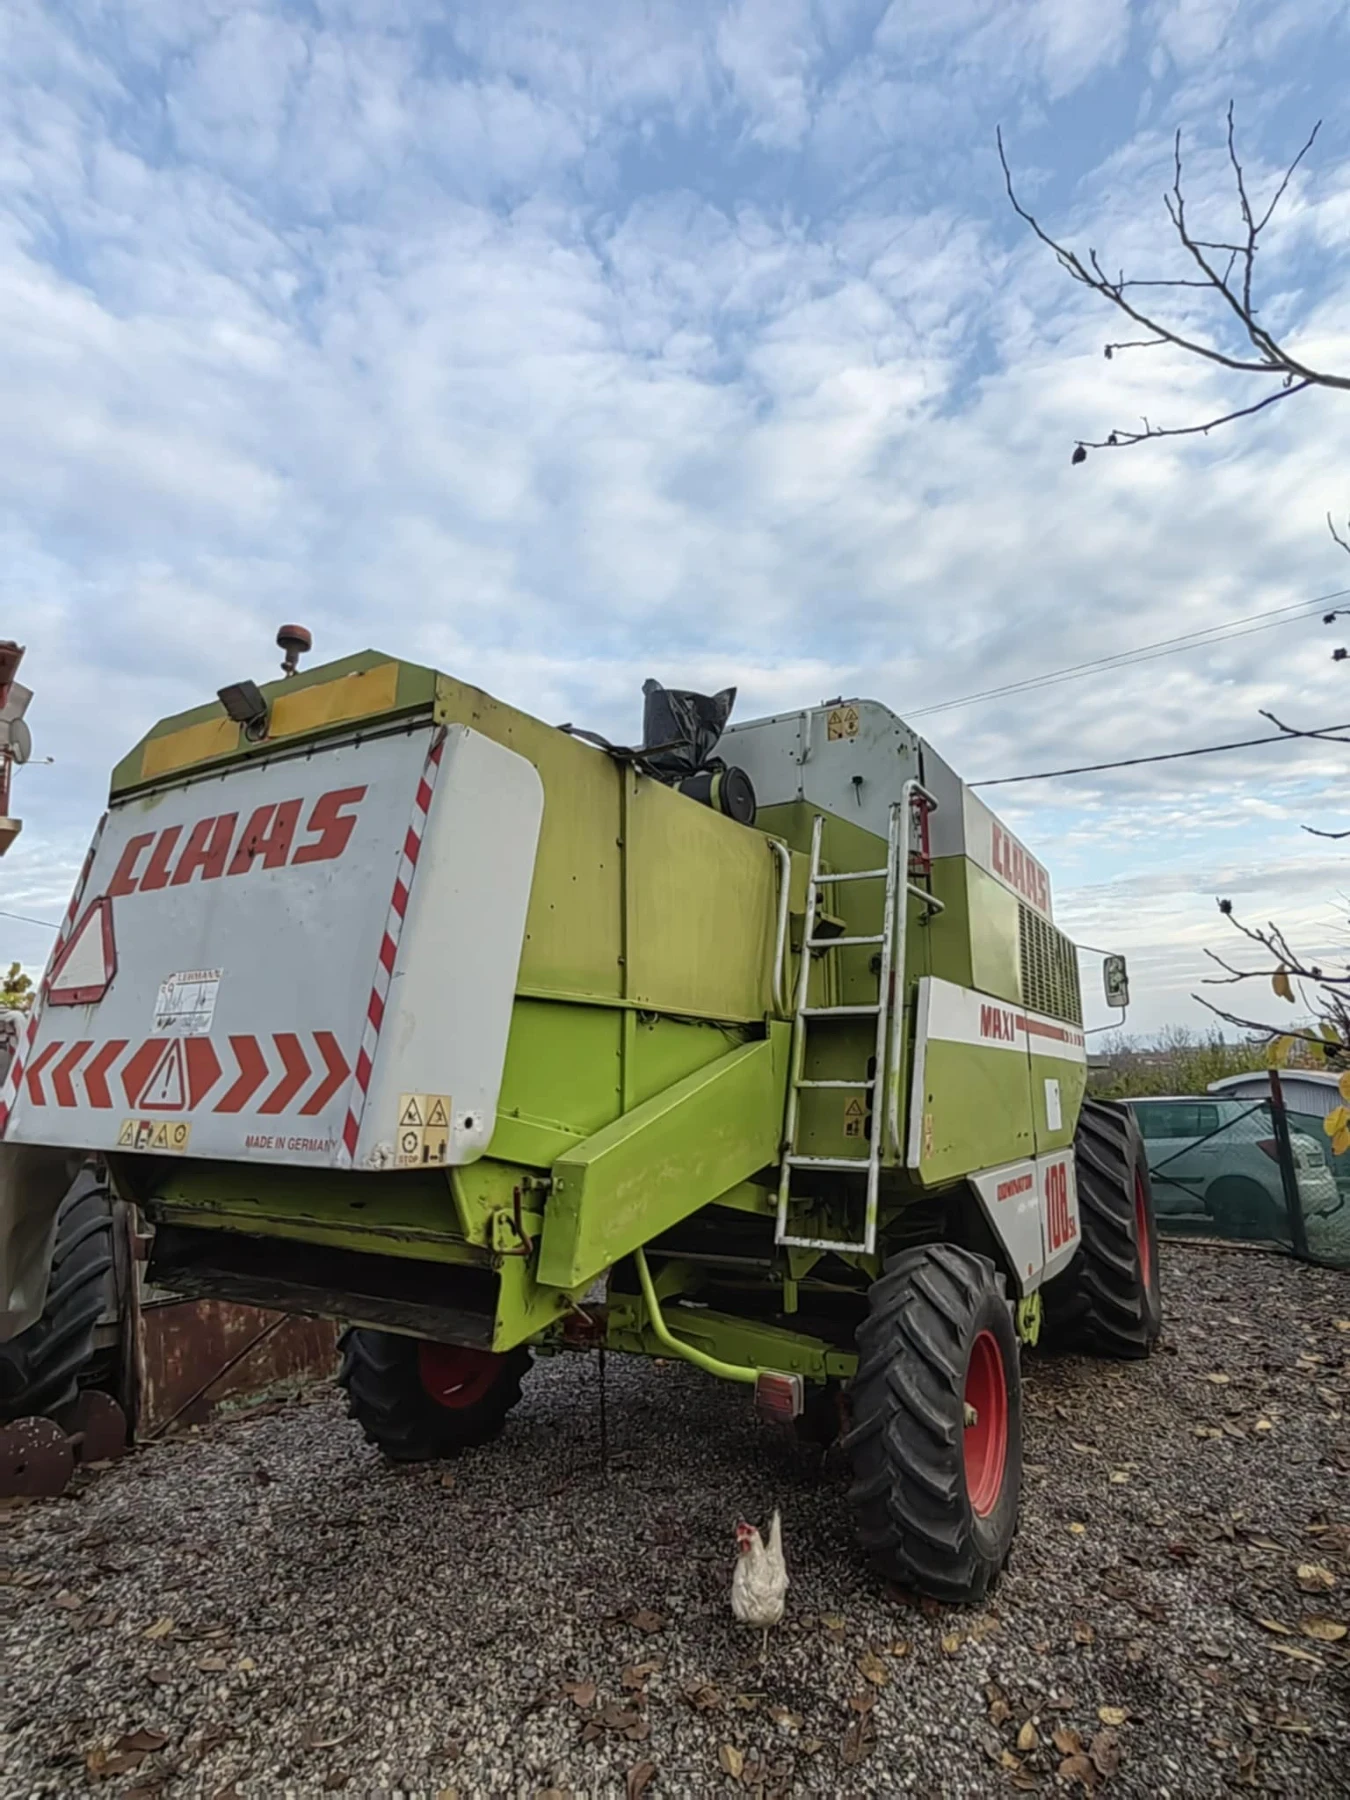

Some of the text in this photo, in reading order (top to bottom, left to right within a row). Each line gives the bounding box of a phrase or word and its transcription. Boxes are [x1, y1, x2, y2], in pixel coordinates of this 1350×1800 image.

[106, 785, 369, 898] CLAAS
[992, 822, 1047, 911] CLAAS
[980, 1004, 1015, 1042] MAXI
[245, 1135, 337, 1152] MADE IN GERMANY
[1045, 1162, 1070, 1253] 108
